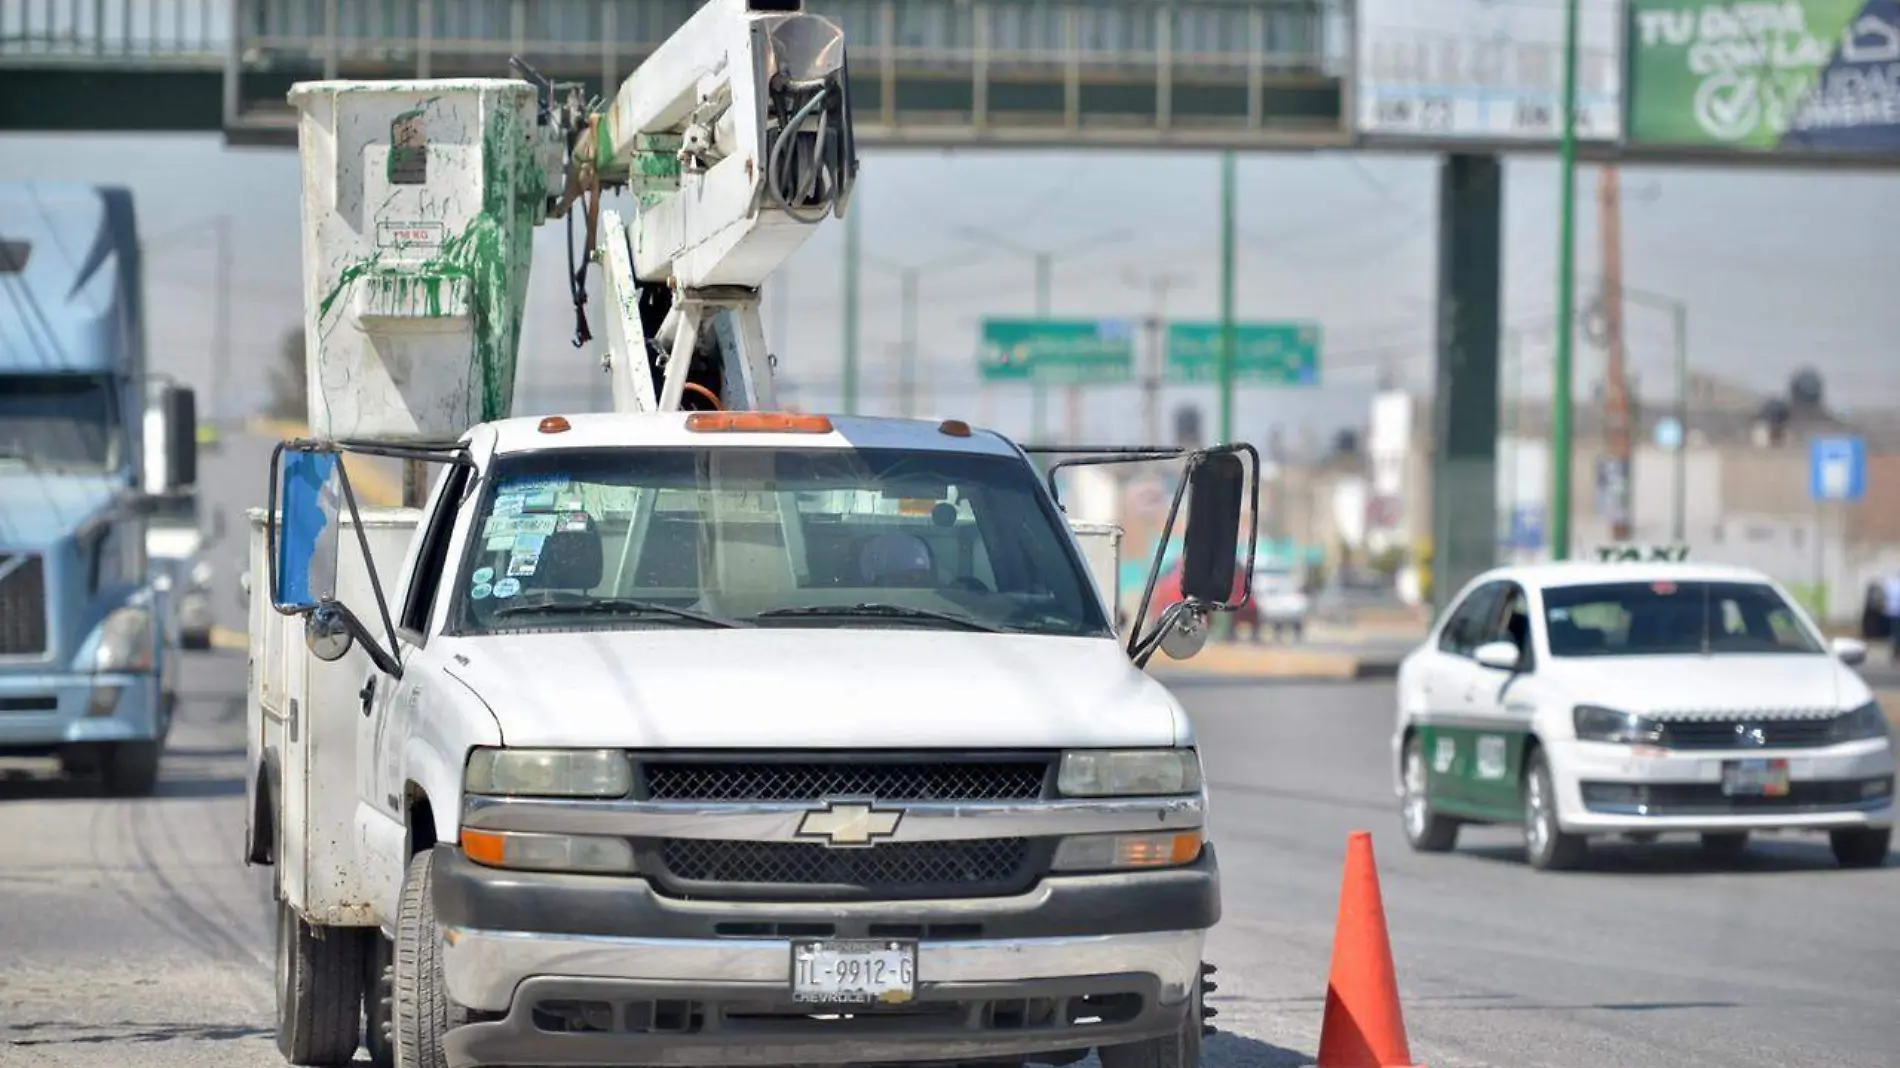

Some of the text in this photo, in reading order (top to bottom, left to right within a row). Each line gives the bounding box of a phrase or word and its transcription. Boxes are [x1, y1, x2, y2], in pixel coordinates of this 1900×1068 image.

[1638, 8, 1695, 46] TU
[1596, 545, 1690, 562] TAXI
[796, 958, 911, 985] TL-9912-G
